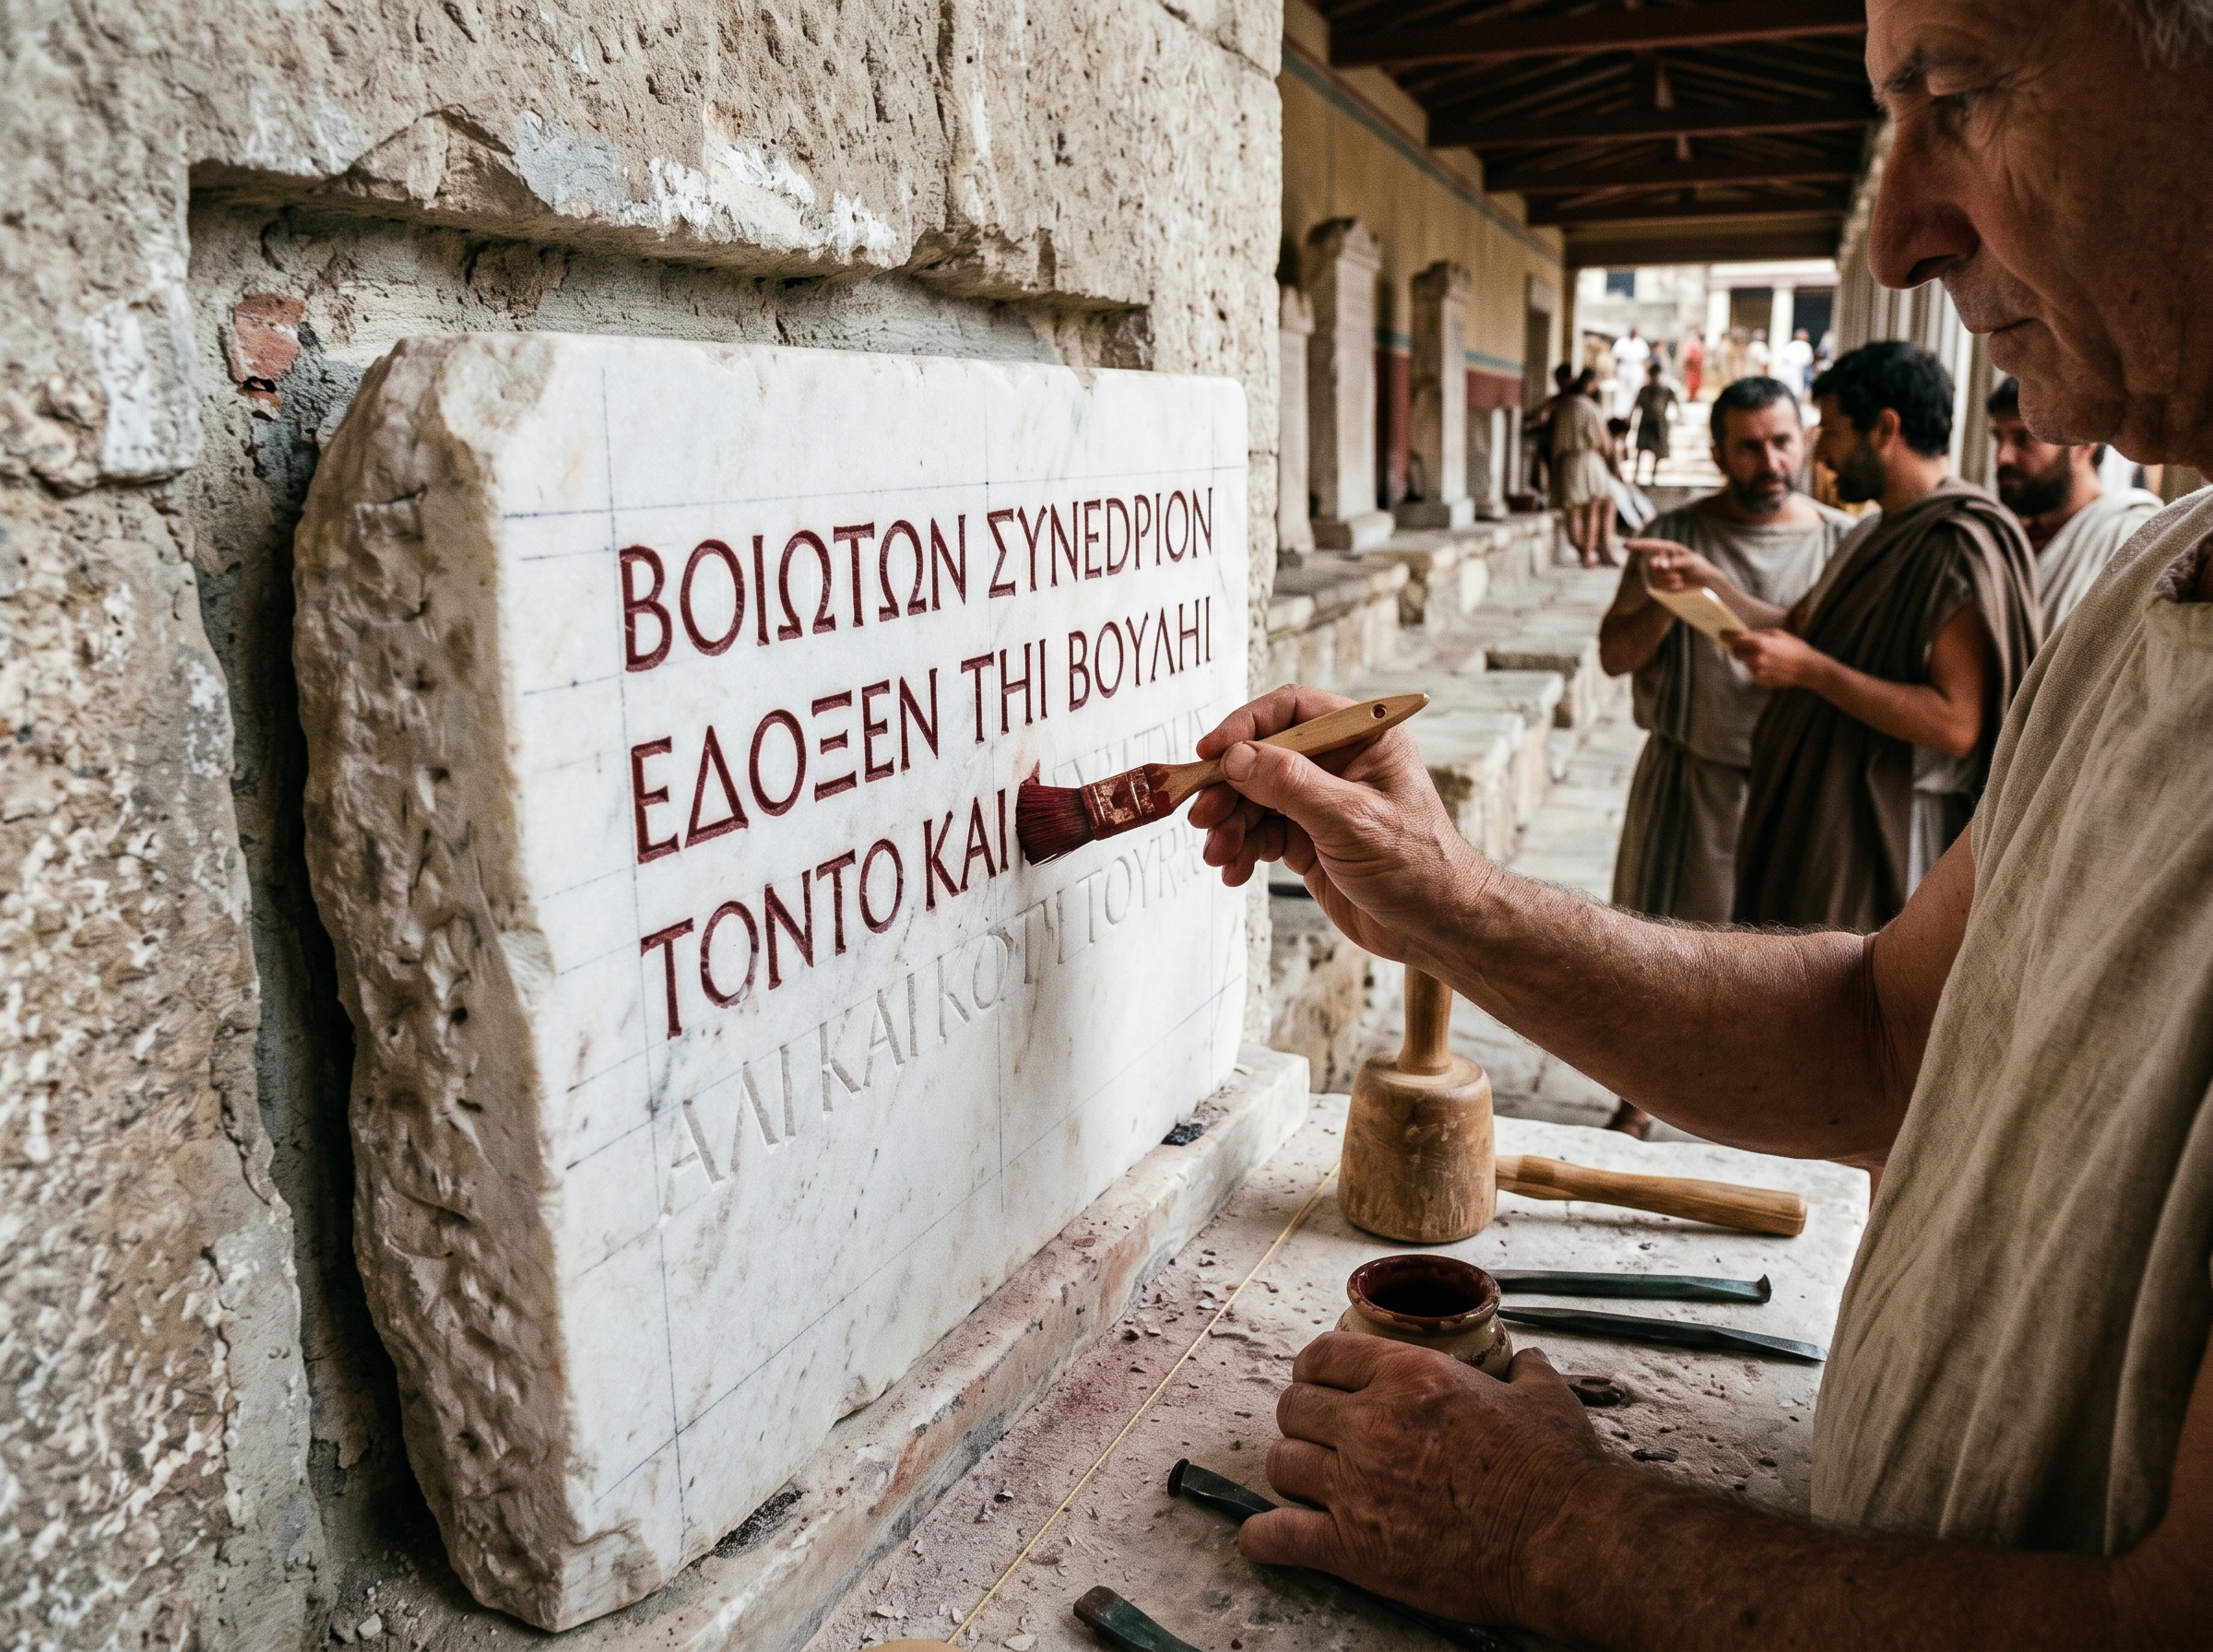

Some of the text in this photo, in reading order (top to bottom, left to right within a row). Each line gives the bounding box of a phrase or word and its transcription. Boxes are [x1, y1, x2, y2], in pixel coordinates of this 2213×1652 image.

[619, 513, 966, 673] ΒΟΙΩΤΩΝ
[631, 667, 939, 865] ΕΔΟΞΕΝ
[961, 638, 1048, 745] ΤΗΙ
[1069, 596, 1211, 713] ΒΟΥΛΗΙ
[641, 788, 1011, 1040] ΤΟΝΤΟ ΚΑΙ
